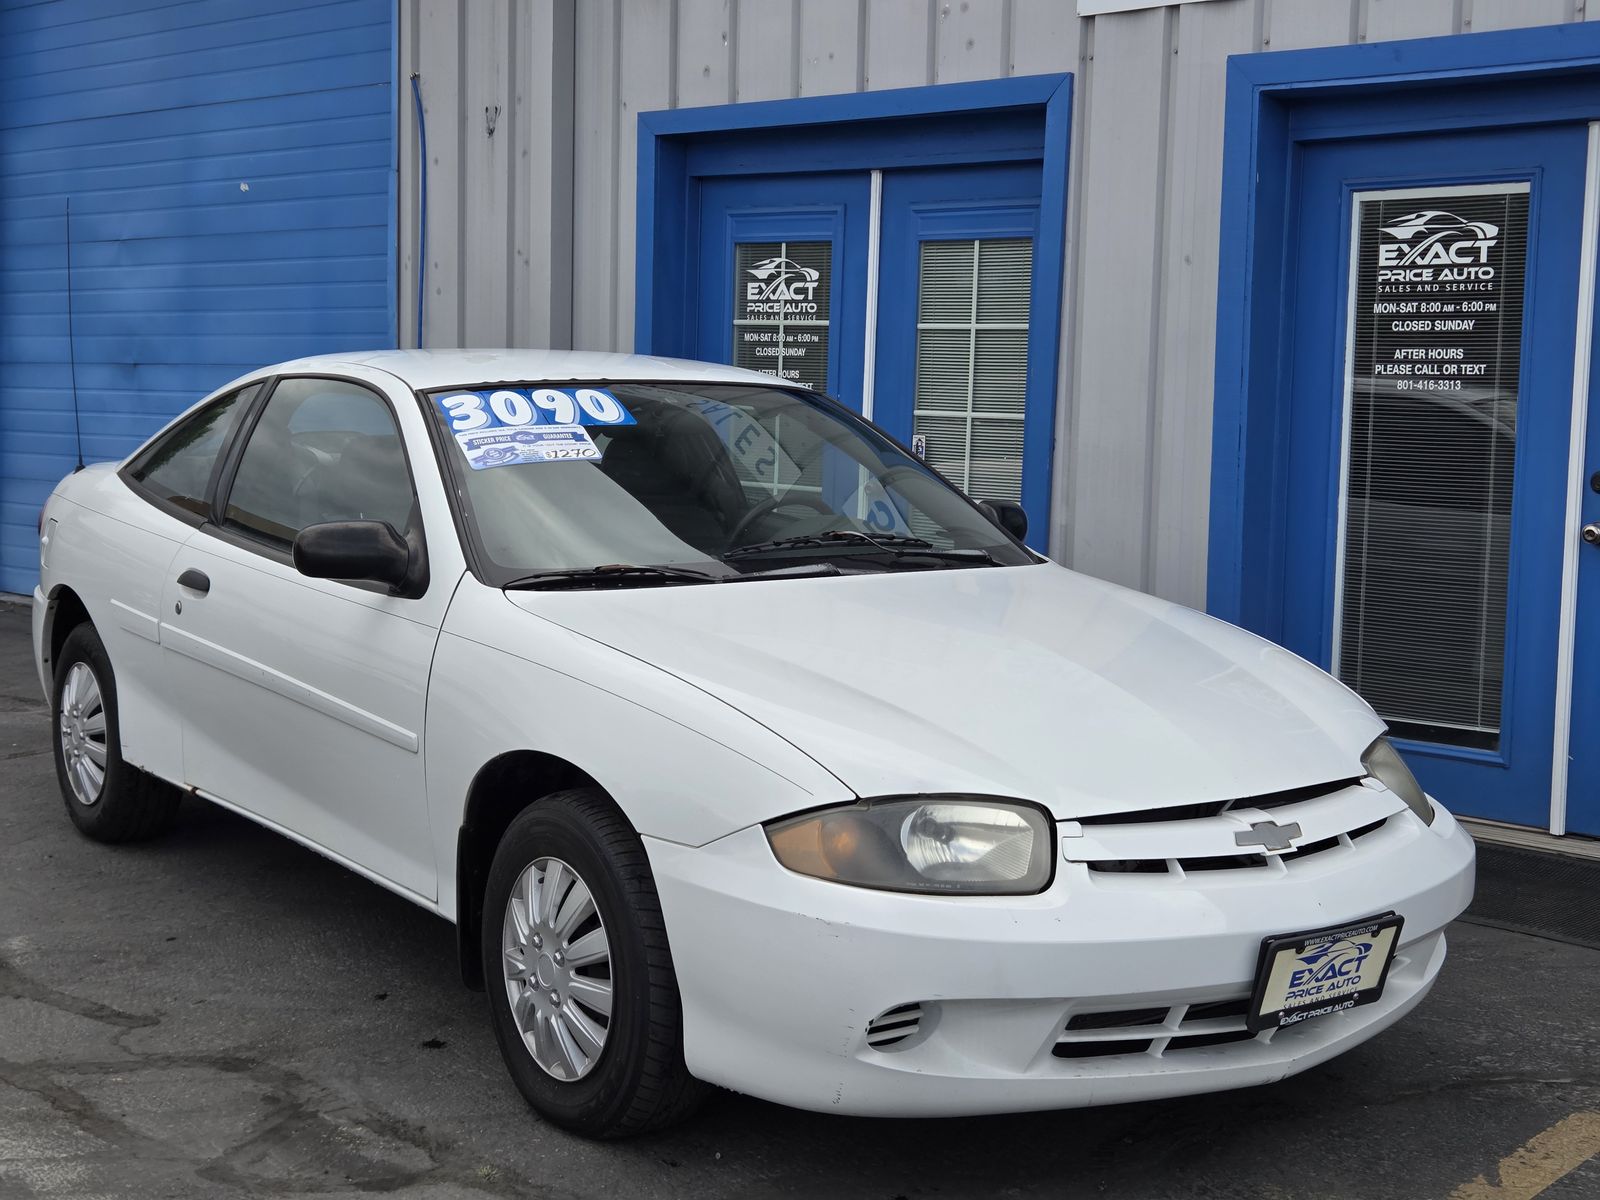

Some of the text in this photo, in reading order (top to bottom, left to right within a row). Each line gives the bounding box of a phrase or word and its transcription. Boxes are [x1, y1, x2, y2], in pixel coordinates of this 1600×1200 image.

[1379, 240, 1497, 266] EXACT
[1378, 267, 1494, 282] PRICE AUTO
[747, 282, 818, 300] EXACT
[1378, 284, 1411, 292] SALES
[1446, 282, 1493, 290] SERVICE
[746, 302, 817, 312] PRICE AUTO
[1374, 302, 1418, 313] MON-SAT
[1420, 302, 1440, 312] 8:00
[1442, 304, 1454, 312] AM
[1462, 302, 1482, 312] 6:00
[1485, 304, 1496, 312] PM
[1392, 320, 1475, 331] CLOSED SUNDAY
[744, 333, 772, 342] MON-SAT
[798, 334, 810, 342] 6:00
[756, 348, 806, 356] CLOSED SUNDAY
[1394, 349, 1464, 360] AFTER HOURS
[1375, 364, 1486, 374] PLEASE CALL OR TEXT
[1397, 380, 1461, 390] 801-416-3313
[442, 389, 622, 430] 3090
[472, 437, 495, 446] STICKER
[1304, 925, 1378, 946] WWW.EXACTPRICEAUTO.COM
[1289, 954, 1369, 988] EXACT
[1285, 976, 1361, 1002] PRICE AUTO
[1280, 1000, 1354, 1025] EXACT PRICE AUTO
